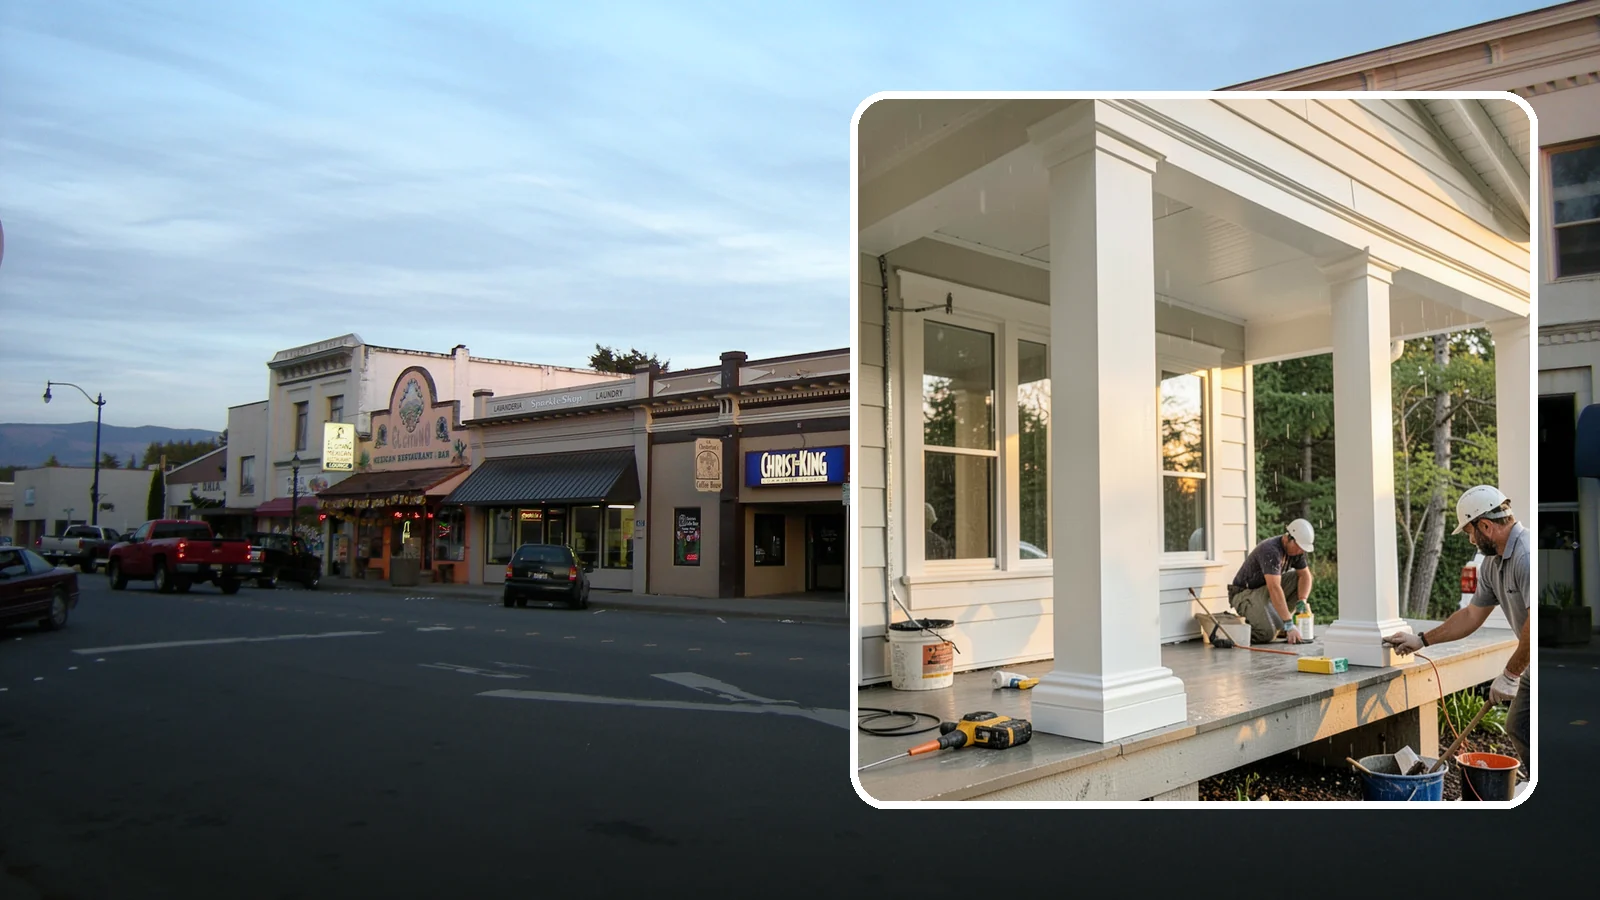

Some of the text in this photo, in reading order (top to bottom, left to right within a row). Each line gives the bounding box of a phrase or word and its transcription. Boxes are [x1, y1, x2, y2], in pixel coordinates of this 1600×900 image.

[561, 394, 583, 404] Shop
[595, 389, 623, 400] LAUNDRY
[493, 402, 522, 412] LAVANDERIA
[397, 452, 433, 462] RESTAURANT
[438, 450, 450, 458] BAR
[799, 450, 827, 476] KING
